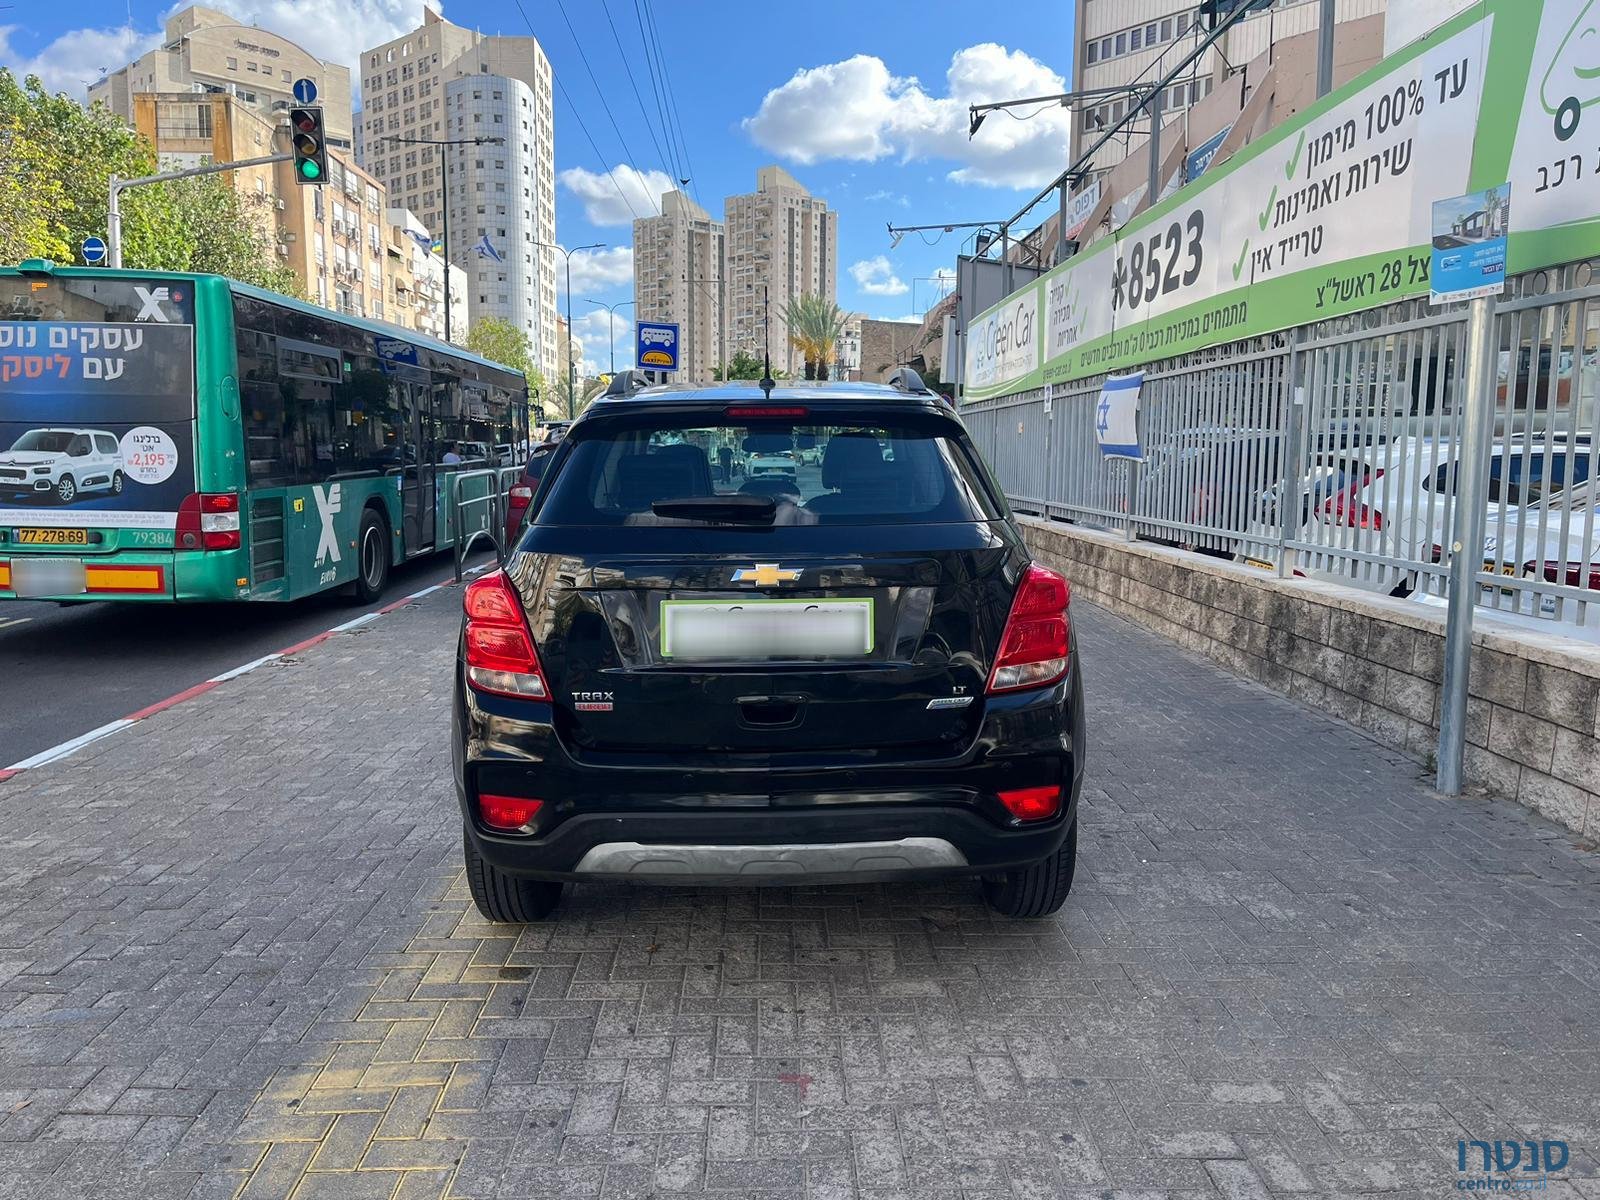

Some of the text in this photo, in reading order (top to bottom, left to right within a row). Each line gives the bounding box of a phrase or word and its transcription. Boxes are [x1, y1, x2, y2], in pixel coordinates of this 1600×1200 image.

[1306, 58, 1469, 180] עד 100% מימון
[1273, 138, 1413, 229] שירות ואמינות
[1535, 154, 1582, 193] רכב
[1250, 225, 1323, 285] טרייד אין
[1379, 259, 1402, 292] 28
[1015, 302, 1035, 348] Car
[1165, 316, 1200, 345] במכירת
[1202, 301, 1247, 334] מתמחים
[49, 326, 143, 354] עסקים
[83, 356, 125, 381] עם
[132, 532, 173, 545] 79384
[571, 691, 614, 701] TRAX
[952, 686, 967, 695] LT
